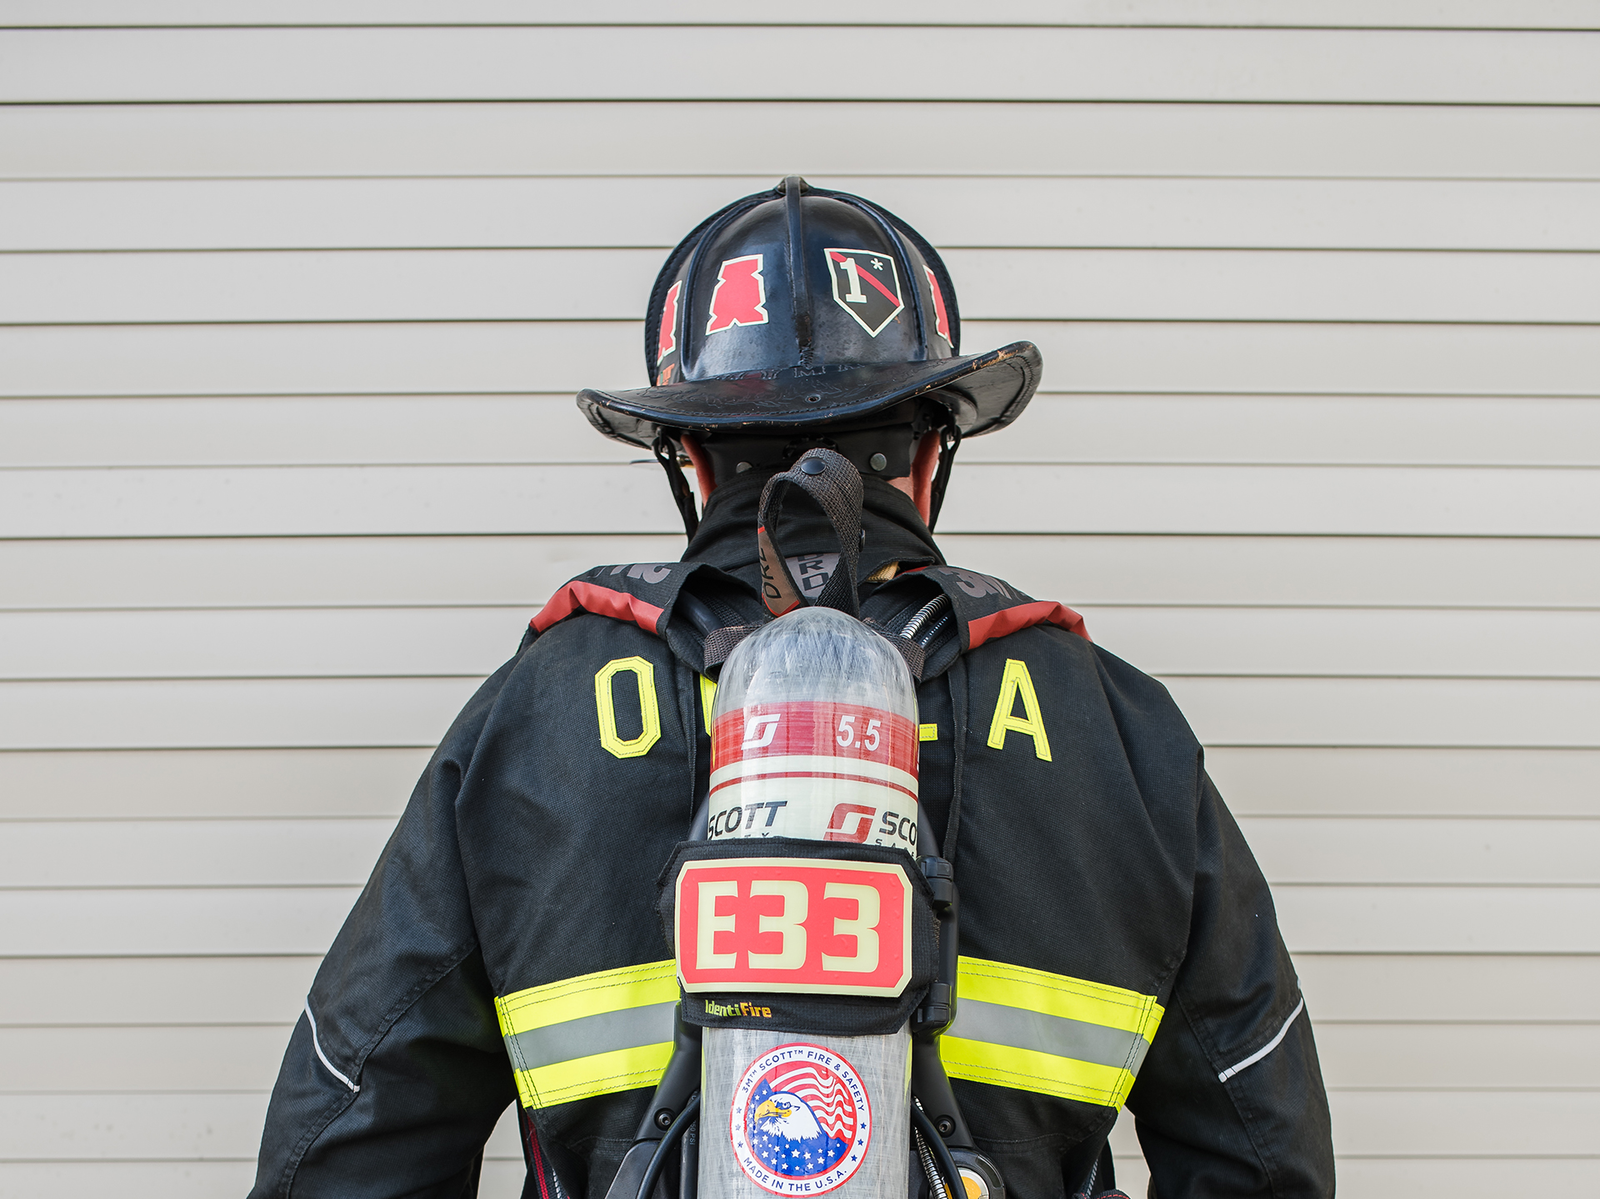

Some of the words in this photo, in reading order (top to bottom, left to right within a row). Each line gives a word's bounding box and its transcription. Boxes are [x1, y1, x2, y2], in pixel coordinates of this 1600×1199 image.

[836, 714, 882, 752] 5.5
[708, 800, 788, 841] SCOTT
[695, 879, 881, 974] E33
[806, 1050, 833, 1066] FIRE
[841, 1070, 865, 1112] SAFETY
[743, 1156, 770, 1184] MADE
[771, 1179, 784, 1190] IN
[788, 1182, 812, 1192] THE
[814, 1169, 848, 1189] U.S.A.
